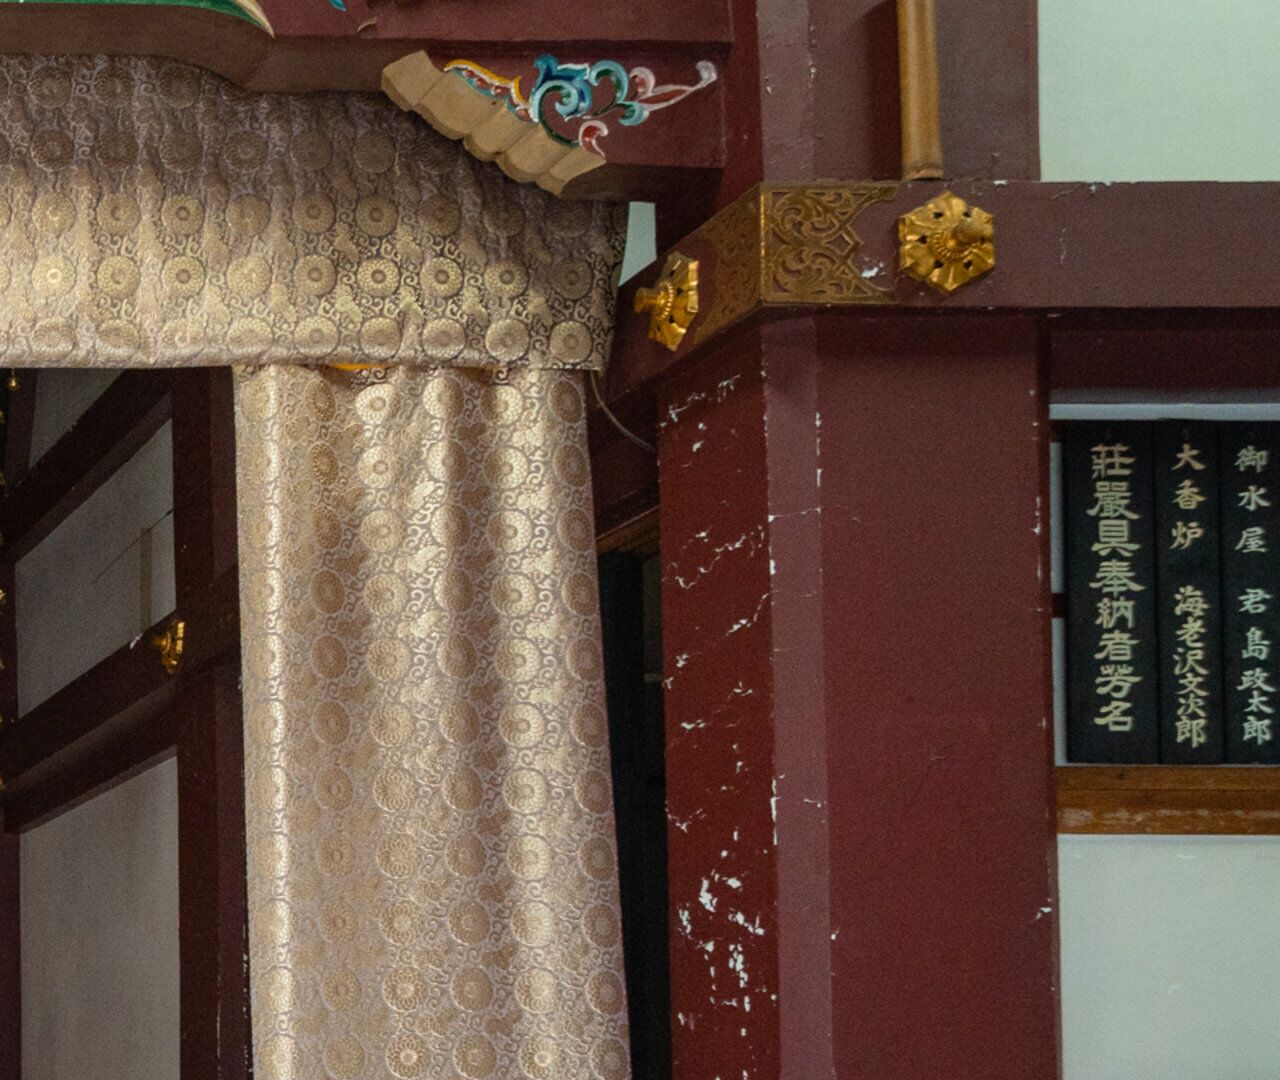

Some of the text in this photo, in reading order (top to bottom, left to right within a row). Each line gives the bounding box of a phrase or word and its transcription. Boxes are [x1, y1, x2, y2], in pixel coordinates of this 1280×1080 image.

[1170, 443, 1210, 749] 大香炉 海老沢文次郎
[1234, 445, 1277, 746] 御水屋 君島政太郎
